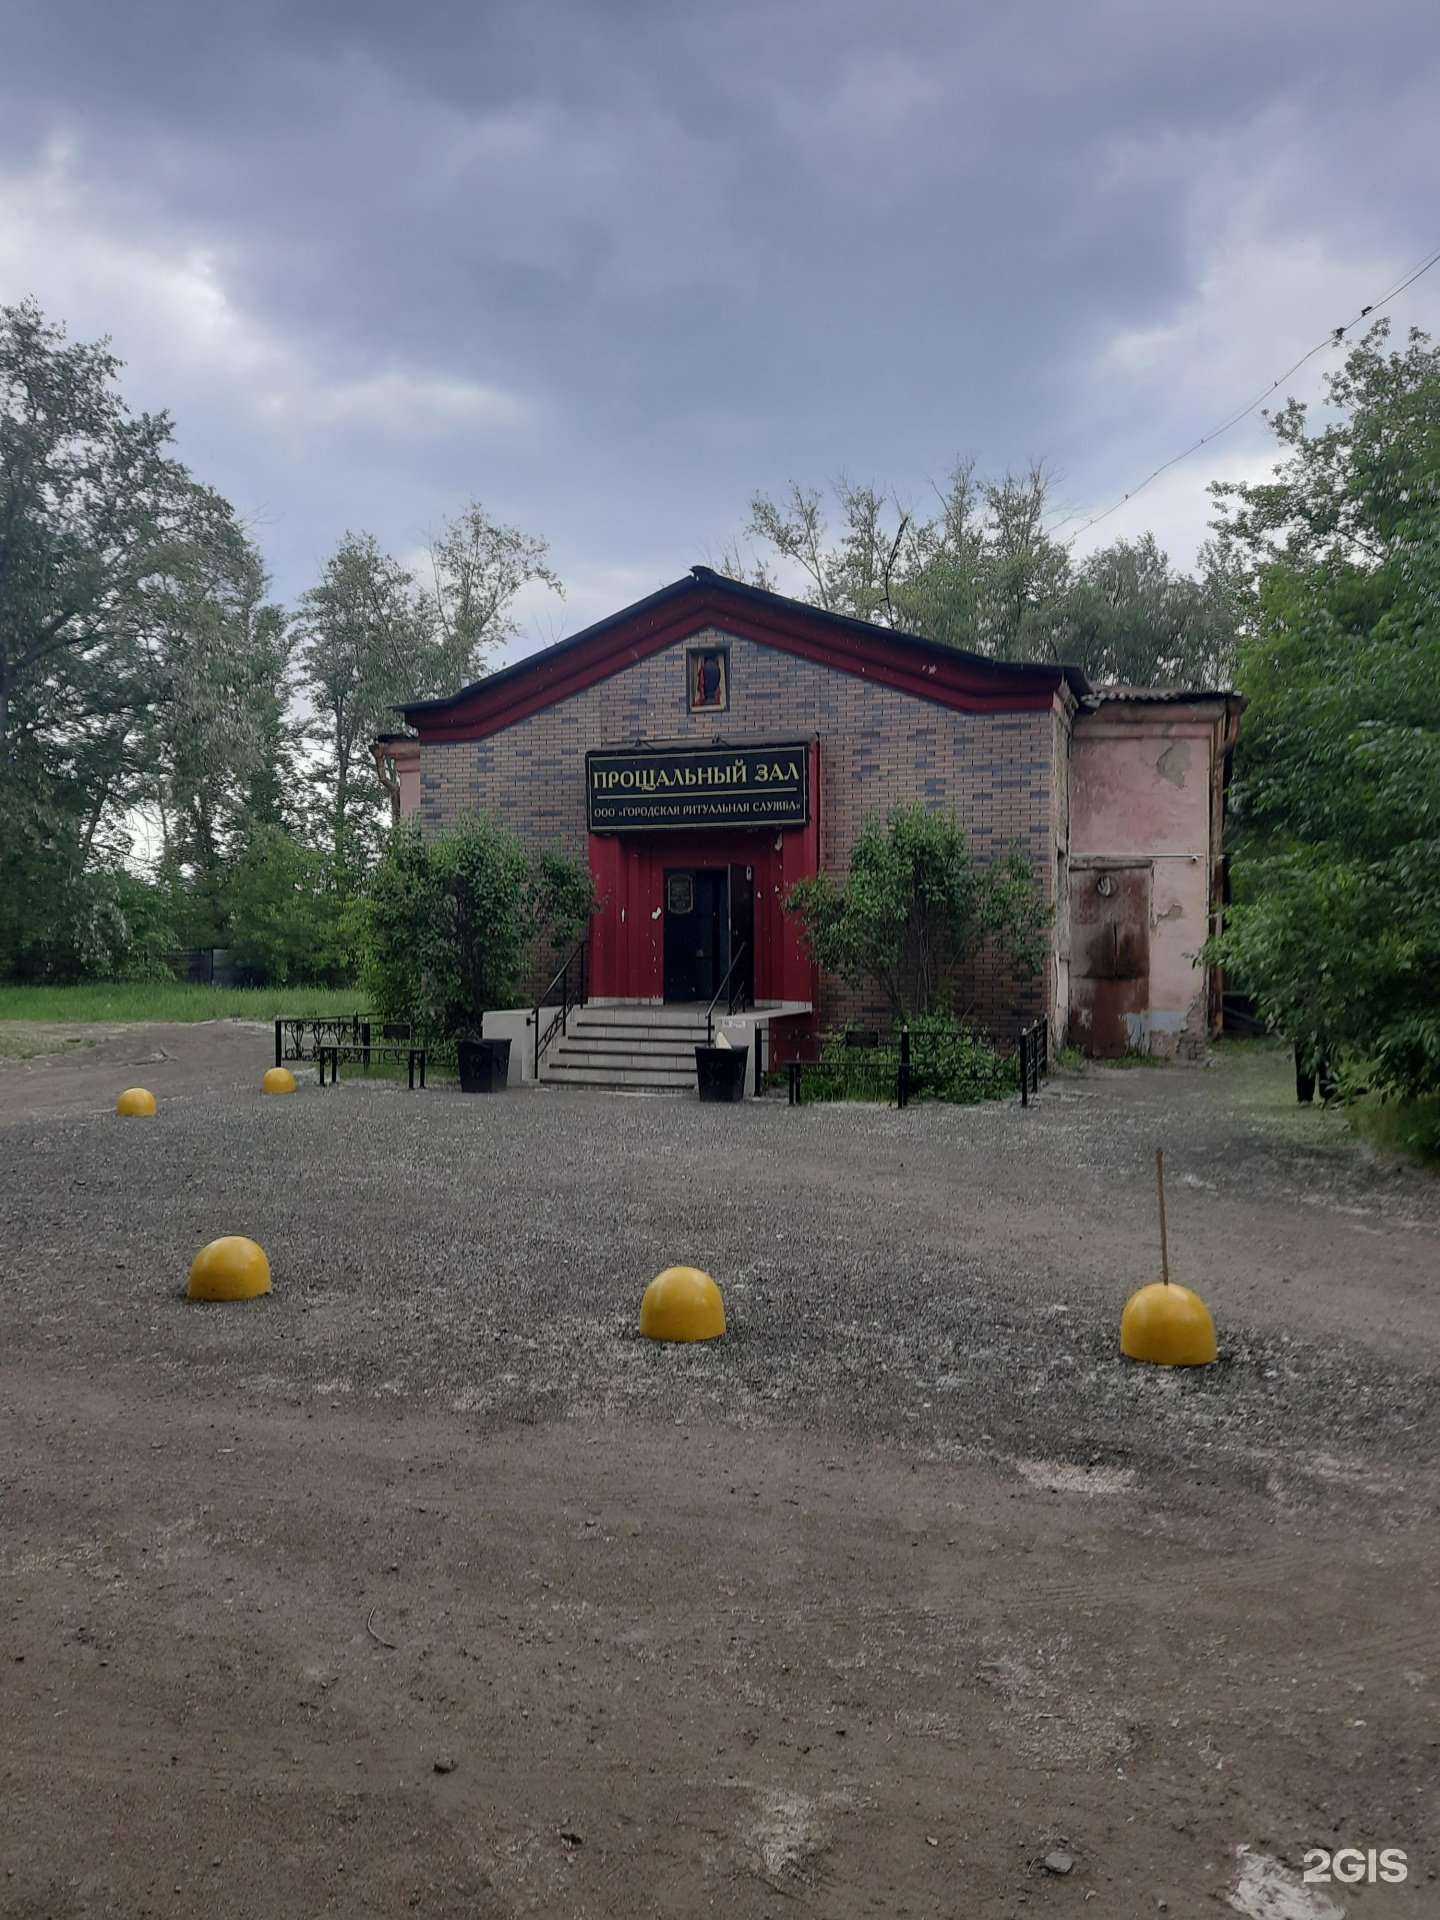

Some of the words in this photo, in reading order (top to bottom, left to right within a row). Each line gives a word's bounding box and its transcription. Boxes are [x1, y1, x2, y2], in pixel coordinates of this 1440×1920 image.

[593, 760, 747, 791] ПРОЩАЛЬНЫЙ
[754, 763, 800, 782] ЗАЛ
[594, 808, 615, 818] ООО
[682, 803, 750, 816] РИТУАЛЬНАЯ
